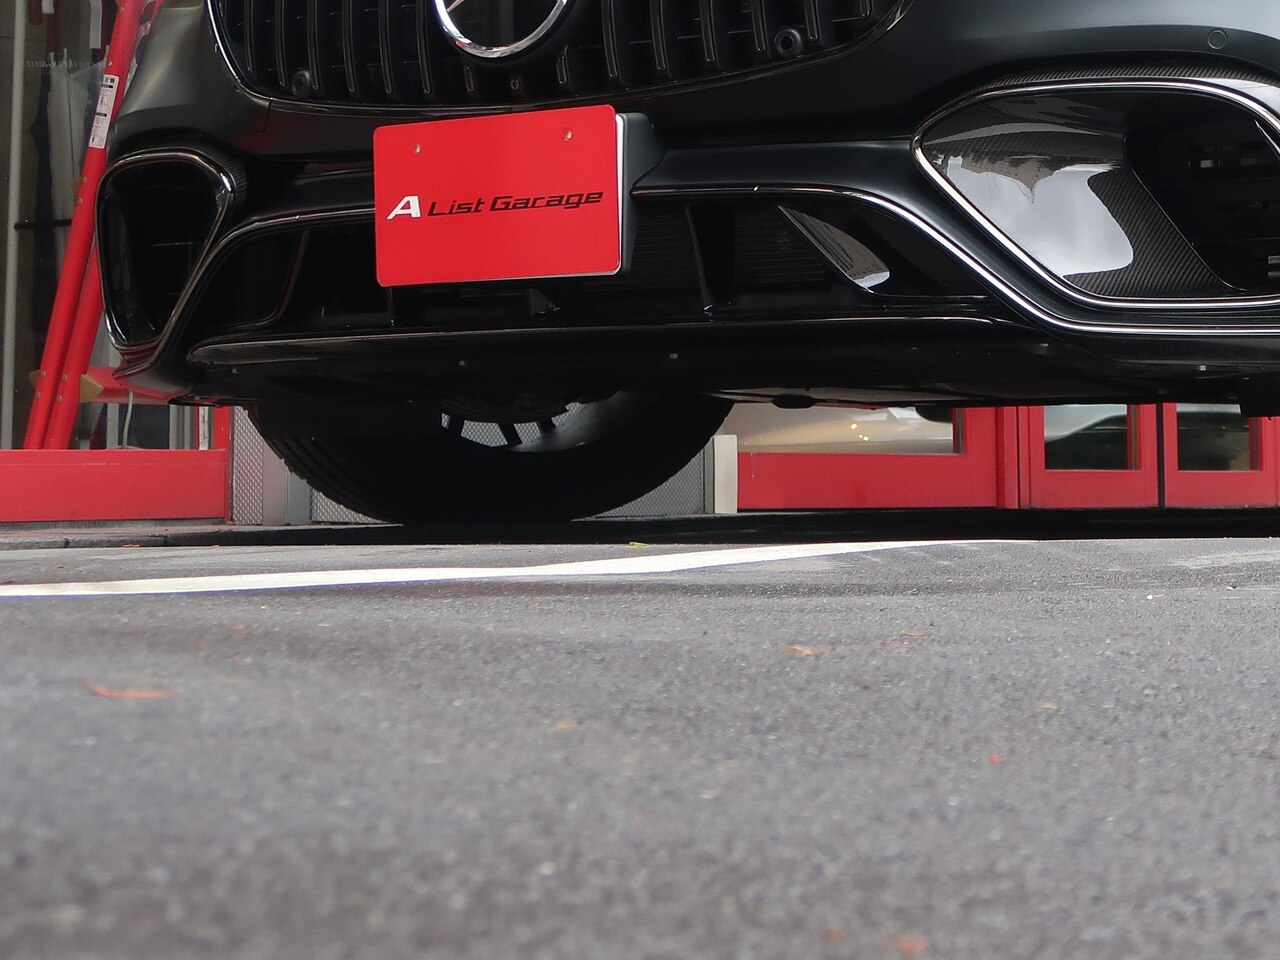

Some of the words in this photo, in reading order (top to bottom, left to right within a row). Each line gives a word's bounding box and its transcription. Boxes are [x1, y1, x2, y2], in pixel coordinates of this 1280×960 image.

[386, 195, 421, 220] A
[427, 199, 486, 217] List
[488, 191, 604, 212] Garage
